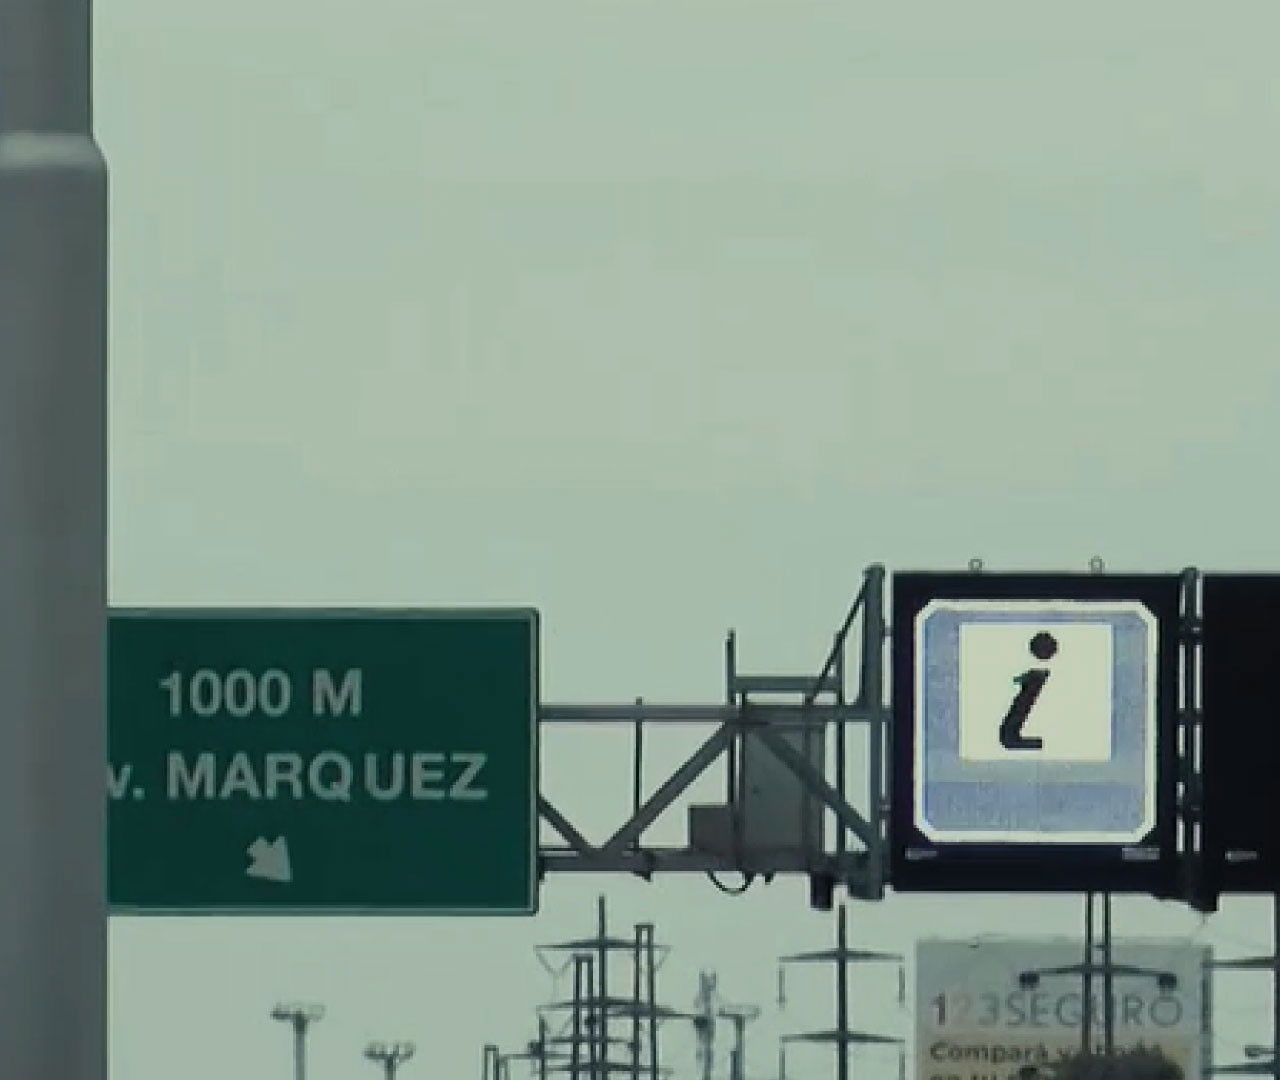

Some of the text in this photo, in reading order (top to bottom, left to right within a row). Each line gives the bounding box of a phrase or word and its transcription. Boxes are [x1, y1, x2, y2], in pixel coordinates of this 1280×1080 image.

[159, 669, 363, 716] 1000 M
[167, 751, 489, 800] MARQUEZ
